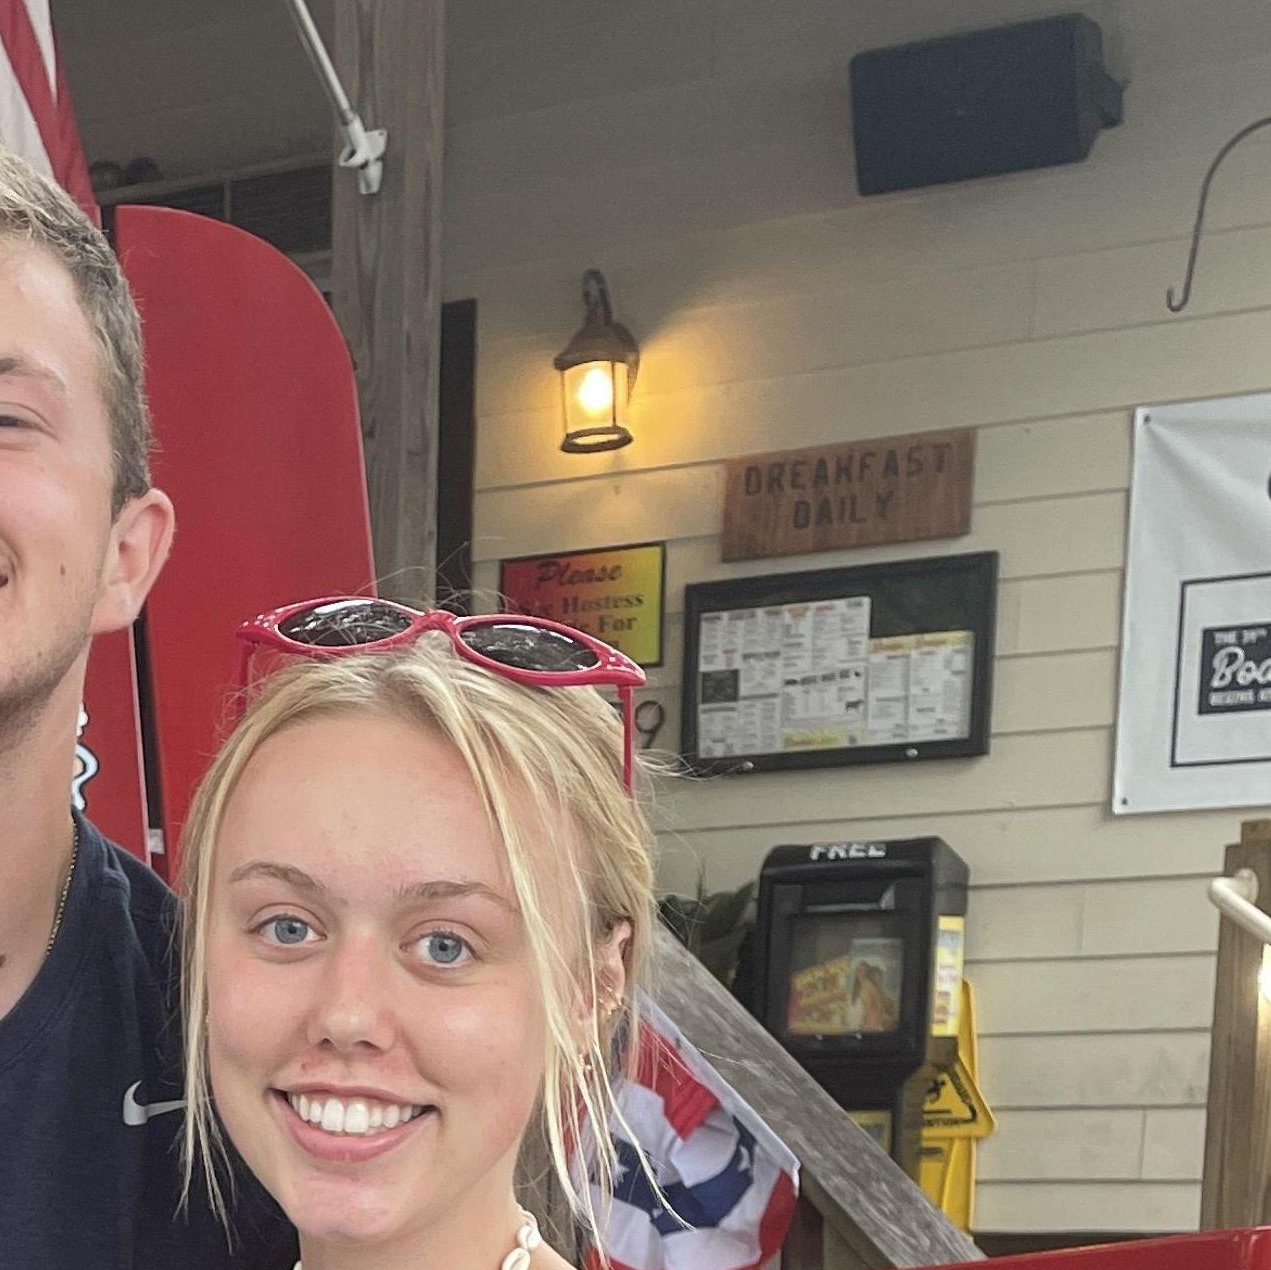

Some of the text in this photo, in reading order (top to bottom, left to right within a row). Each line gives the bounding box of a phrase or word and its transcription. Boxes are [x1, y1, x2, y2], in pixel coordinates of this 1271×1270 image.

[744, 442, 953, 497] BREAKFAST
[793, 491, 893, 530] DAILY
[534, 559, 623, 590] Please
[562, 593, 645, 614] Hostess
[598, 615, 638, 633] For
[810, 843, 888, 861] FREE
